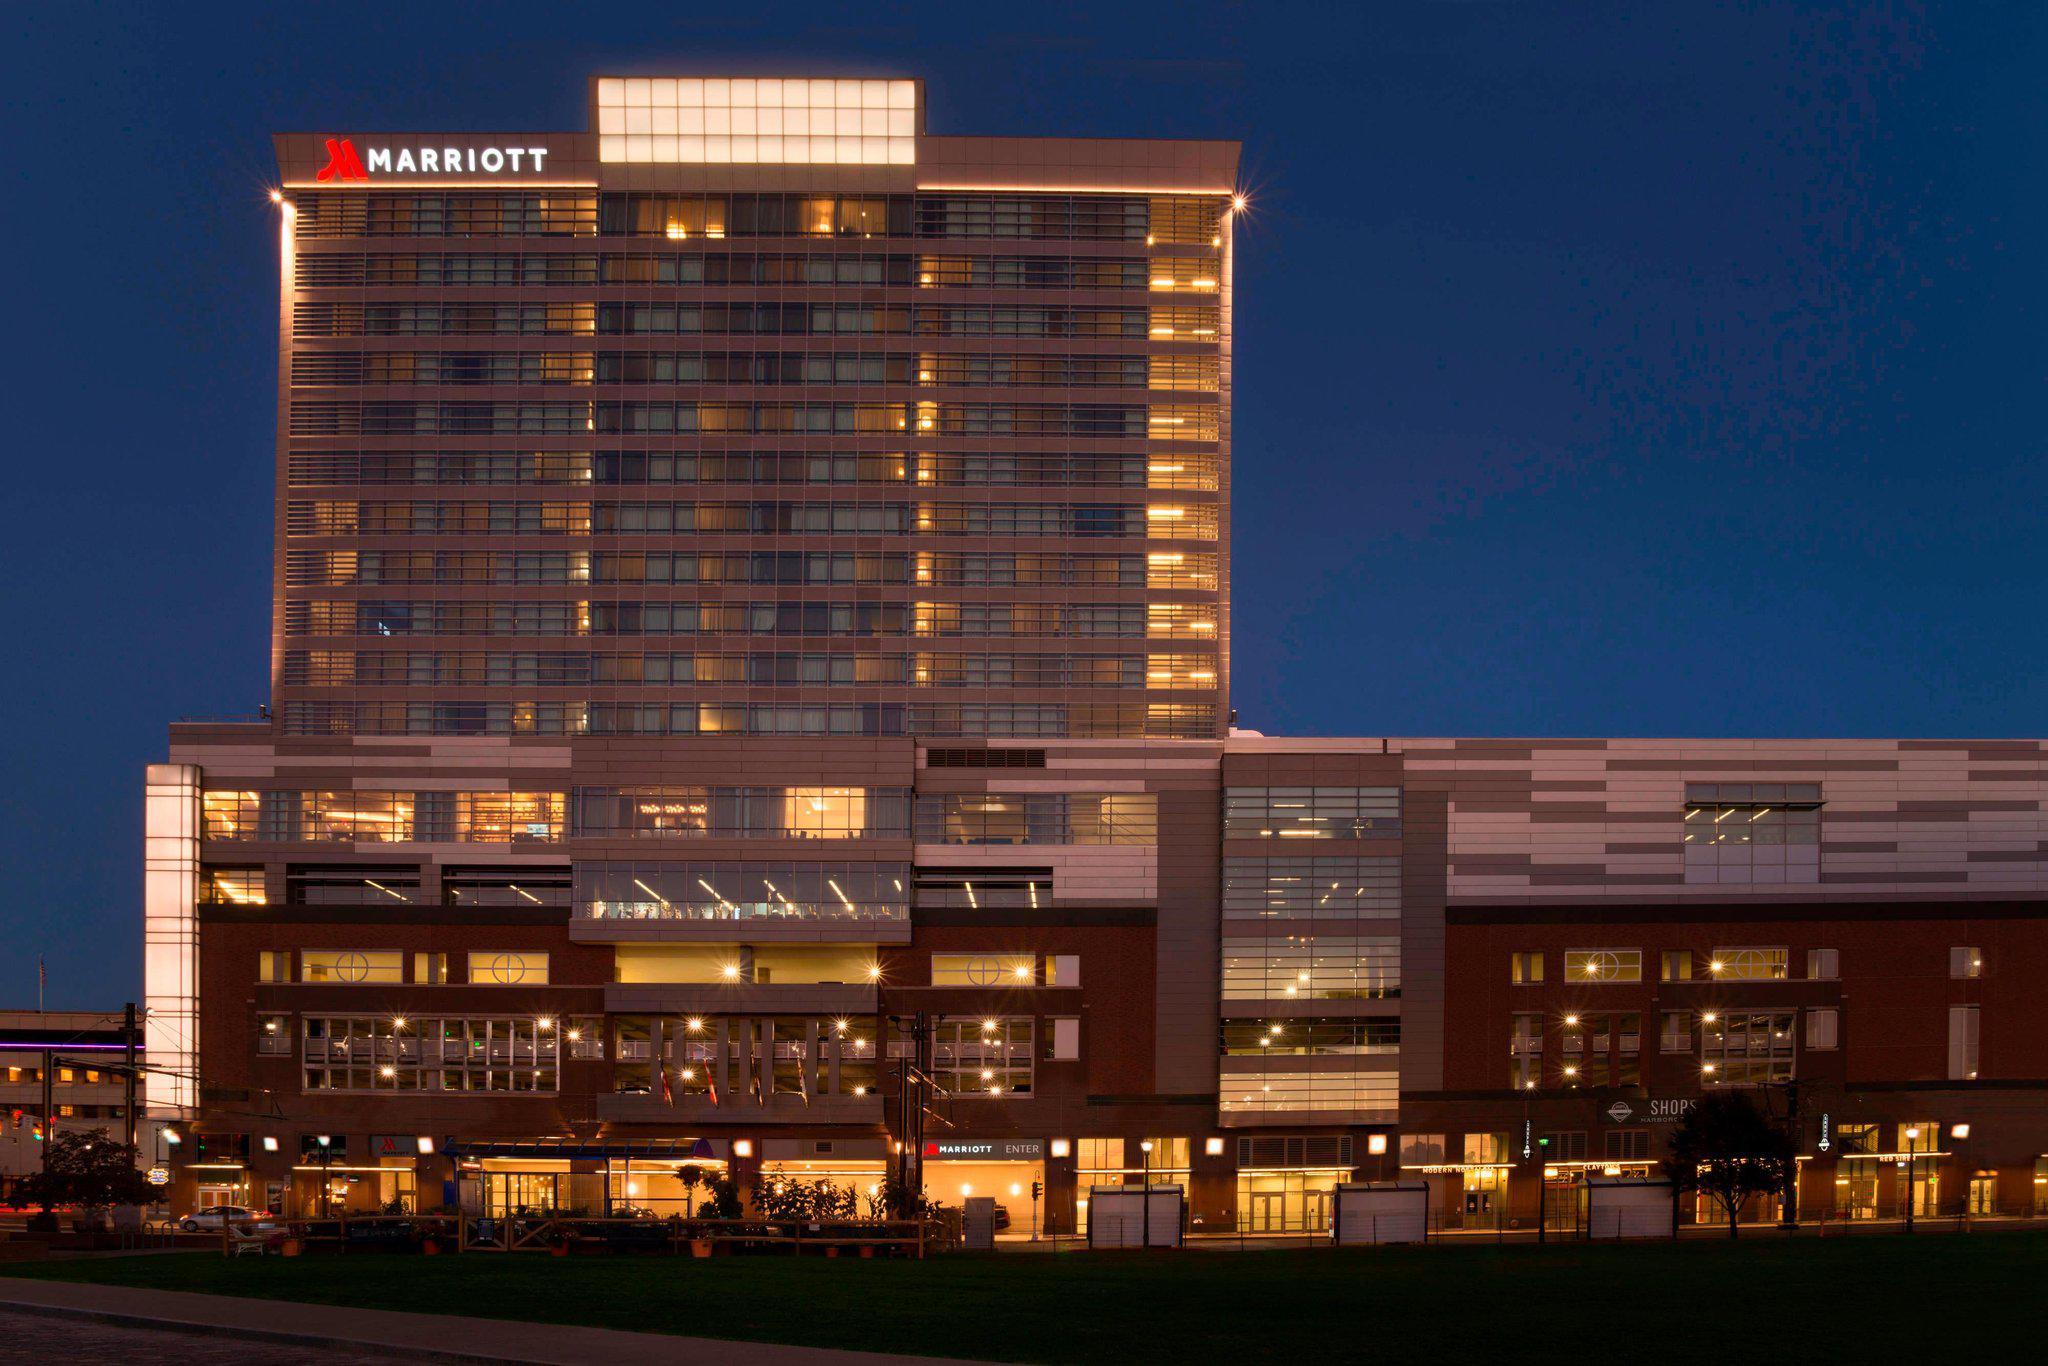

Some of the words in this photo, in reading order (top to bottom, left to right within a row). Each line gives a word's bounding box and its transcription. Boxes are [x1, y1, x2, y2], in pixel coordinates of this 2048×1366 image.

[368, 148, 547, 172] MARRIOTT
[939, 1145, 993, 1153] MARRIOTT
[1005, 1144, 1039, 1154] ENTER
